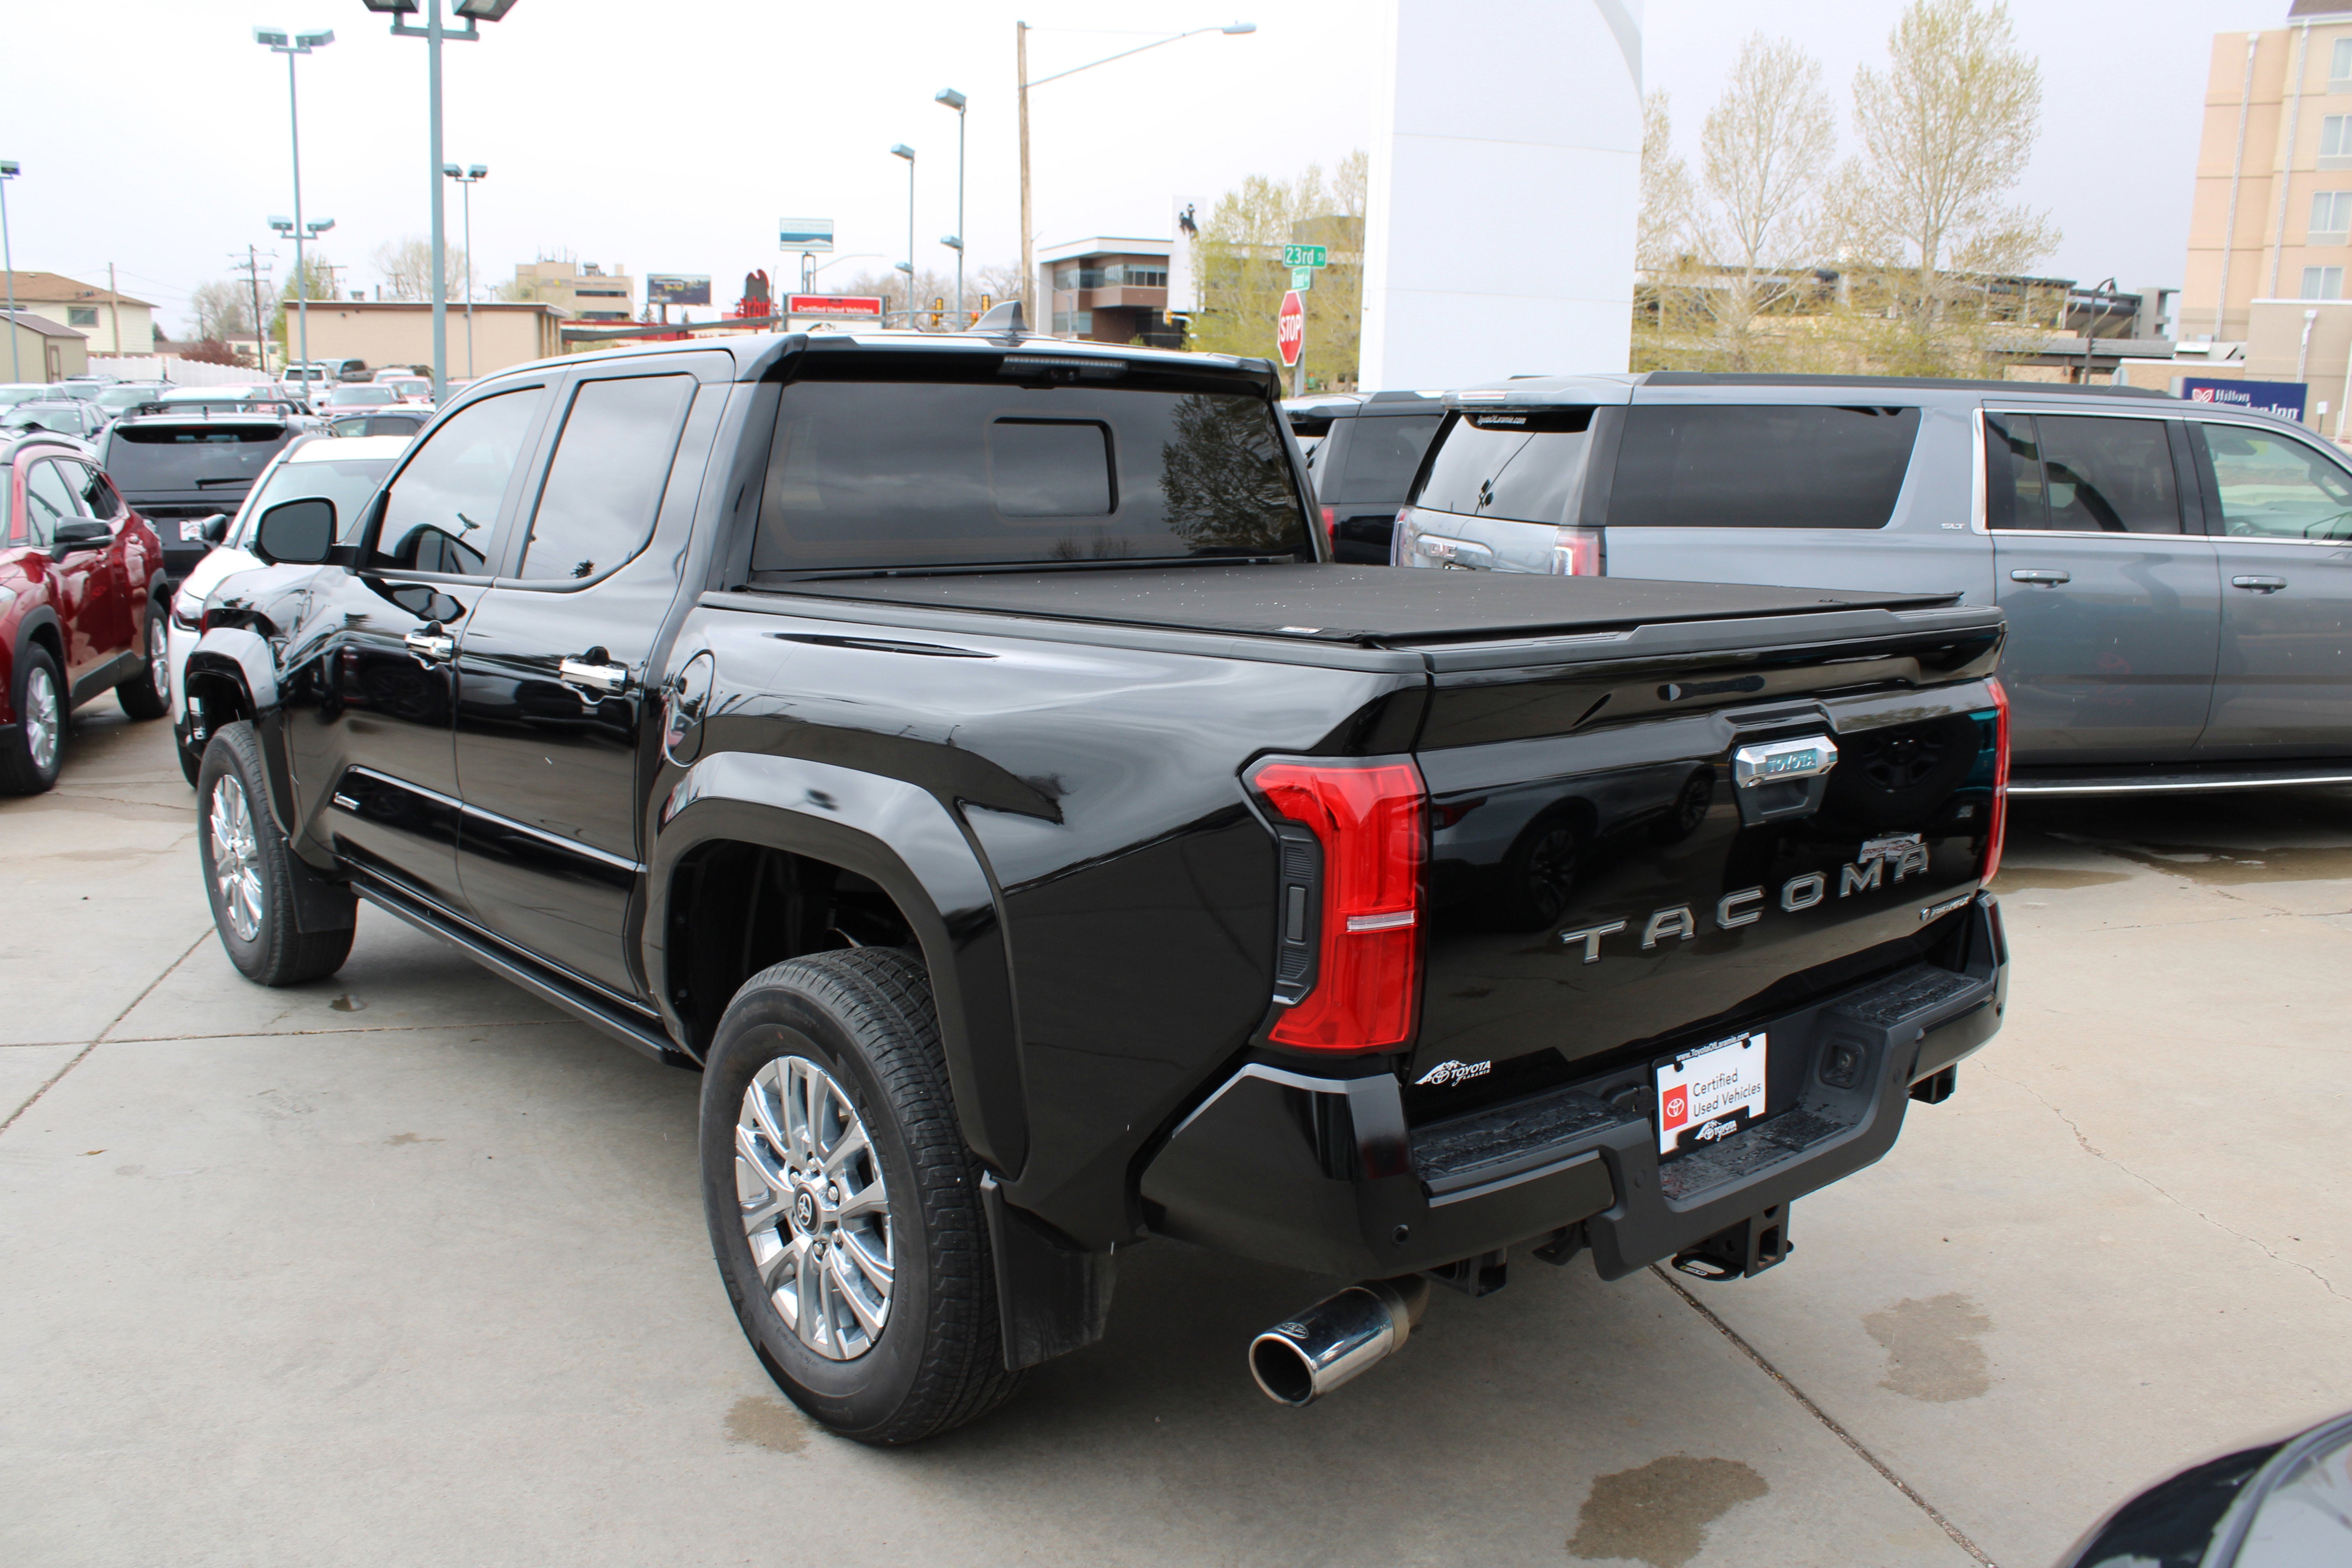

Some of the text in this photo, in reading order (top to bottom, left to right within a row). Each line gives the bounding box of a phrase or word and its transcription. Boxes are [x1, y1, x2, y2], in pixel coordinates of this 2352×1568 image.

[1286, 247, 1314, 265] 23rd
[1280, 314, 1301, 343] STOP
[2215, 389, 2250, 403] Hilton
[2271, 403, 2300, 420] Inn
[1430, 542, 1457, 559] GMC
[1768, 751, 1815, 773] TOYOTA
[1559, 842, 1930, 964] TACOMA
[1451, 1060, 1490, 1079] TOYOTA
[1693, 1068, 1738, 1097] Certified
[1694, 1083, 1761, 1116] Used Vehicles
[1714, 1120, 1737, 1135] TOYOTA
